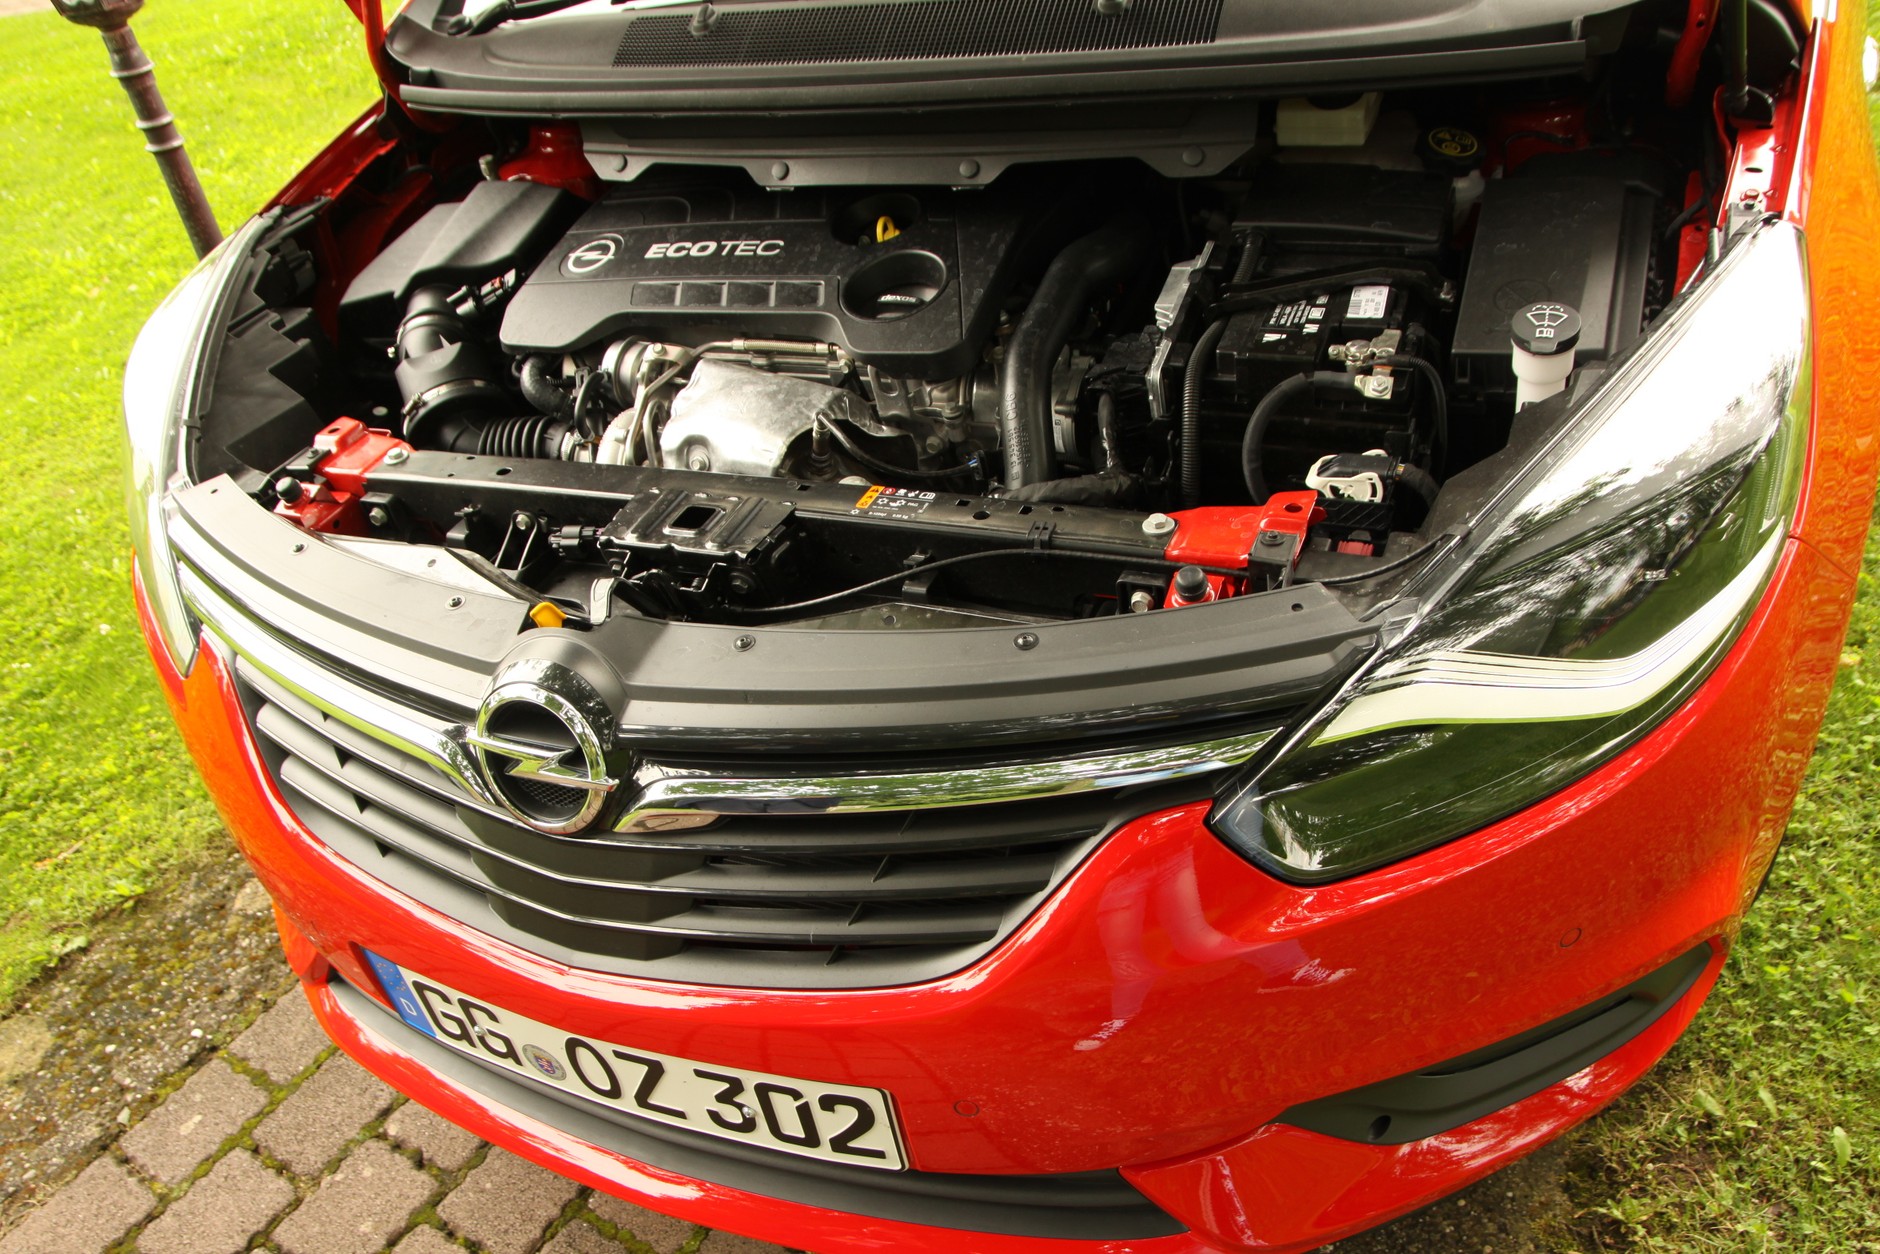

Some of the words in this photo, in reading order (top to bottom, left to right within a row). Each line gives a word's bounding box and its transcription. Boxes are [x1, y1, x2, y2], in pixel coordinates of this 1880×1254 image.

[644, 239, 785, 259] ECOTEC
[880, 294, 917, 303] dexos
[412, 980, 523, 1067] GG
[565, 1037, 687, 1120] OZ
[693, 1068, 886, 1159] 302
